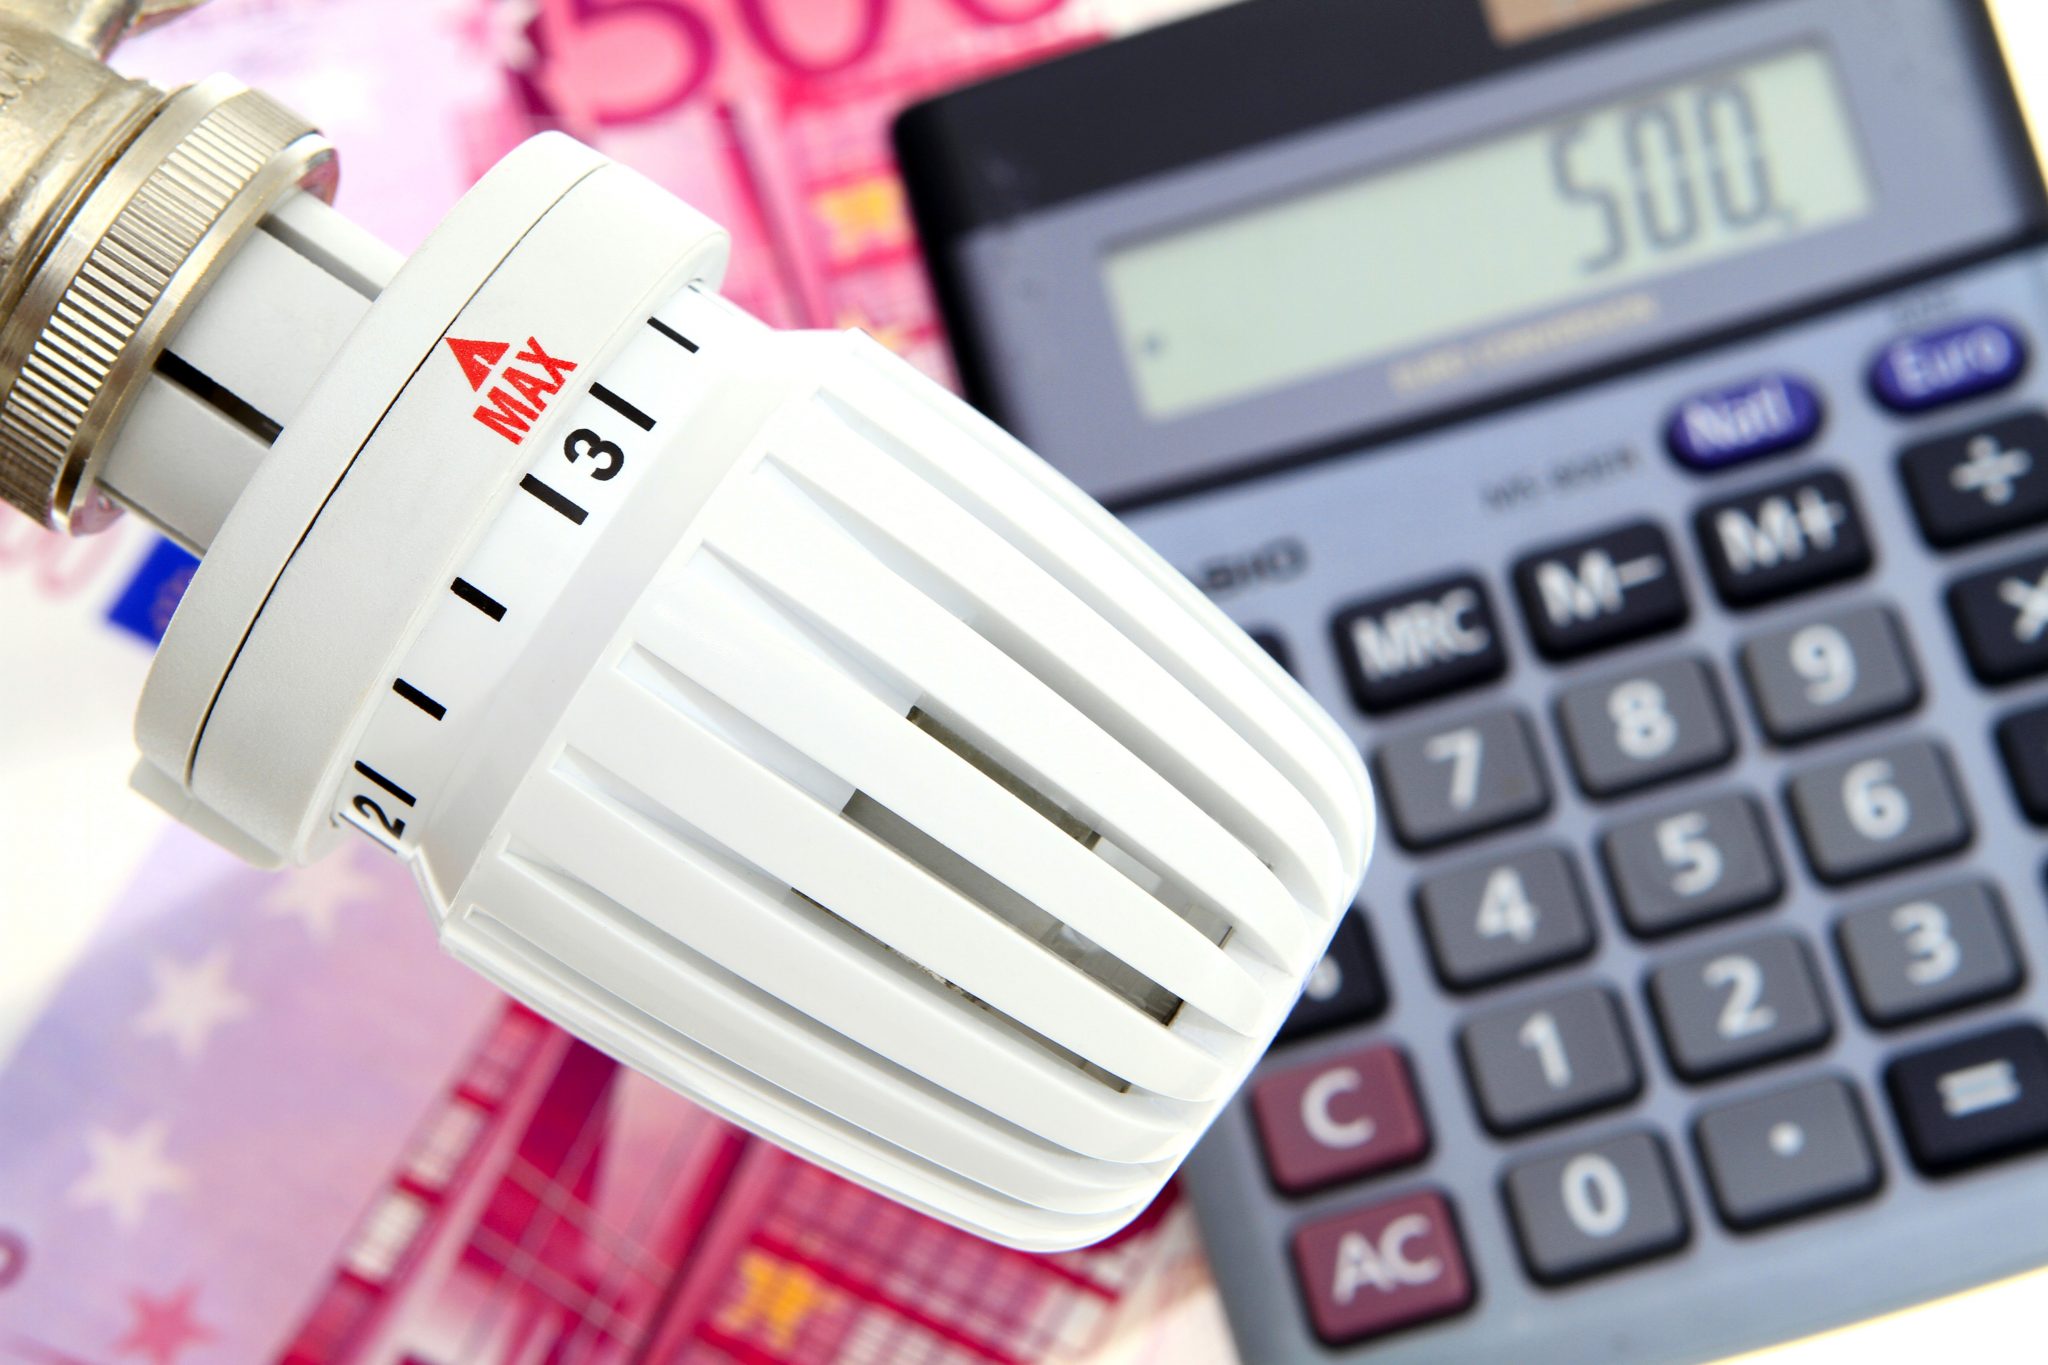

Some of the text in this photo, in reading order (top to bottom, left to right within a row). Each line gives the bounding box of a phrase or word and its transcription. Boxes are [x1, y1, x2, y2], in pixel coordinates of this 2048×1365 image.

[473, 336, 578, 445] MAX
[1889, 323, 2013, 398] Euro
[564, 428, 624, 481] 3
[1714, 485, 1848, 574] M+
[1350, 588, 1489, 682] MRC
[1790, 624, 1856, 704] 9
[1608, 678, 1677, 760] 8
[1426, 729, 1484, 811] 7
[1841, 758, 1908, 840] 6
[353, 795, 405, 840] 2
[1655, 814, 1722, 896] 5
[1475, 867, 1540, 942] 4
[1891, 901, 1960, 984] 3
[1704, 956, 1777, 1039] 2
[1518, 1013, 1571, 1089] 1
[1299, 1069, 1374, 1149] C
[1561, 1153, 1627, 1237] 0
[1333, 1213, 1444, 1306] AC
